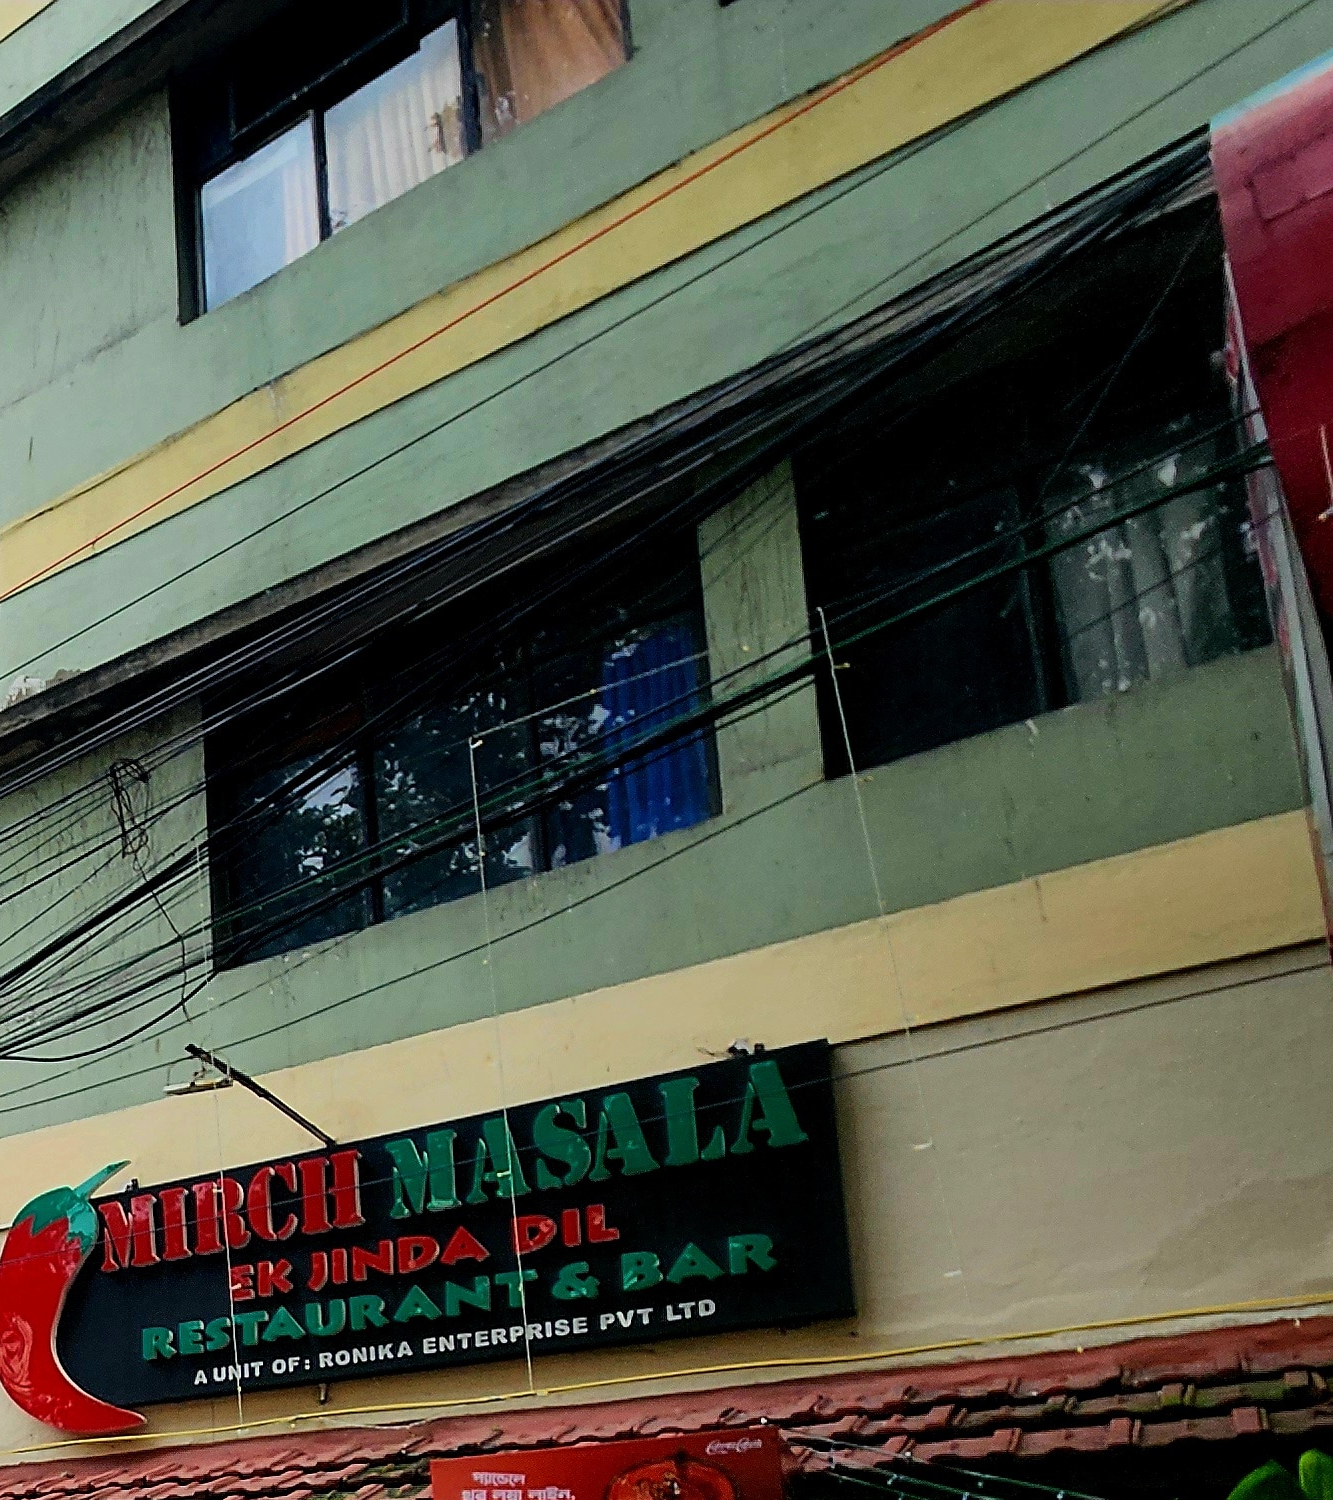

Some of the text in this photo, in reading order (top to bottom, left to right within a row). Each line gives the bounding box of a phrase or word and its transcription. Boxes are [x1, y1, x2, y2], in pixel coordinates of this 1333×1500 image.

[98, 1060, 810, 1273] MIRCH MASALA
[141, 1233, 779, 1361] RESTAURANT & BAR
[230, 1204, 620, 1301] EK JINDA DIL
[194, 1370, 208, 1386] A
[212, 1361, 264, 1382] UNIT
[319, 1341, 413, 1368] RONIKA
[422, 1316, 589, 1355] ENTERPRISE
[599, 1305, 654, 1332] PVT
[666, 1299, 717, 1323] LTD
